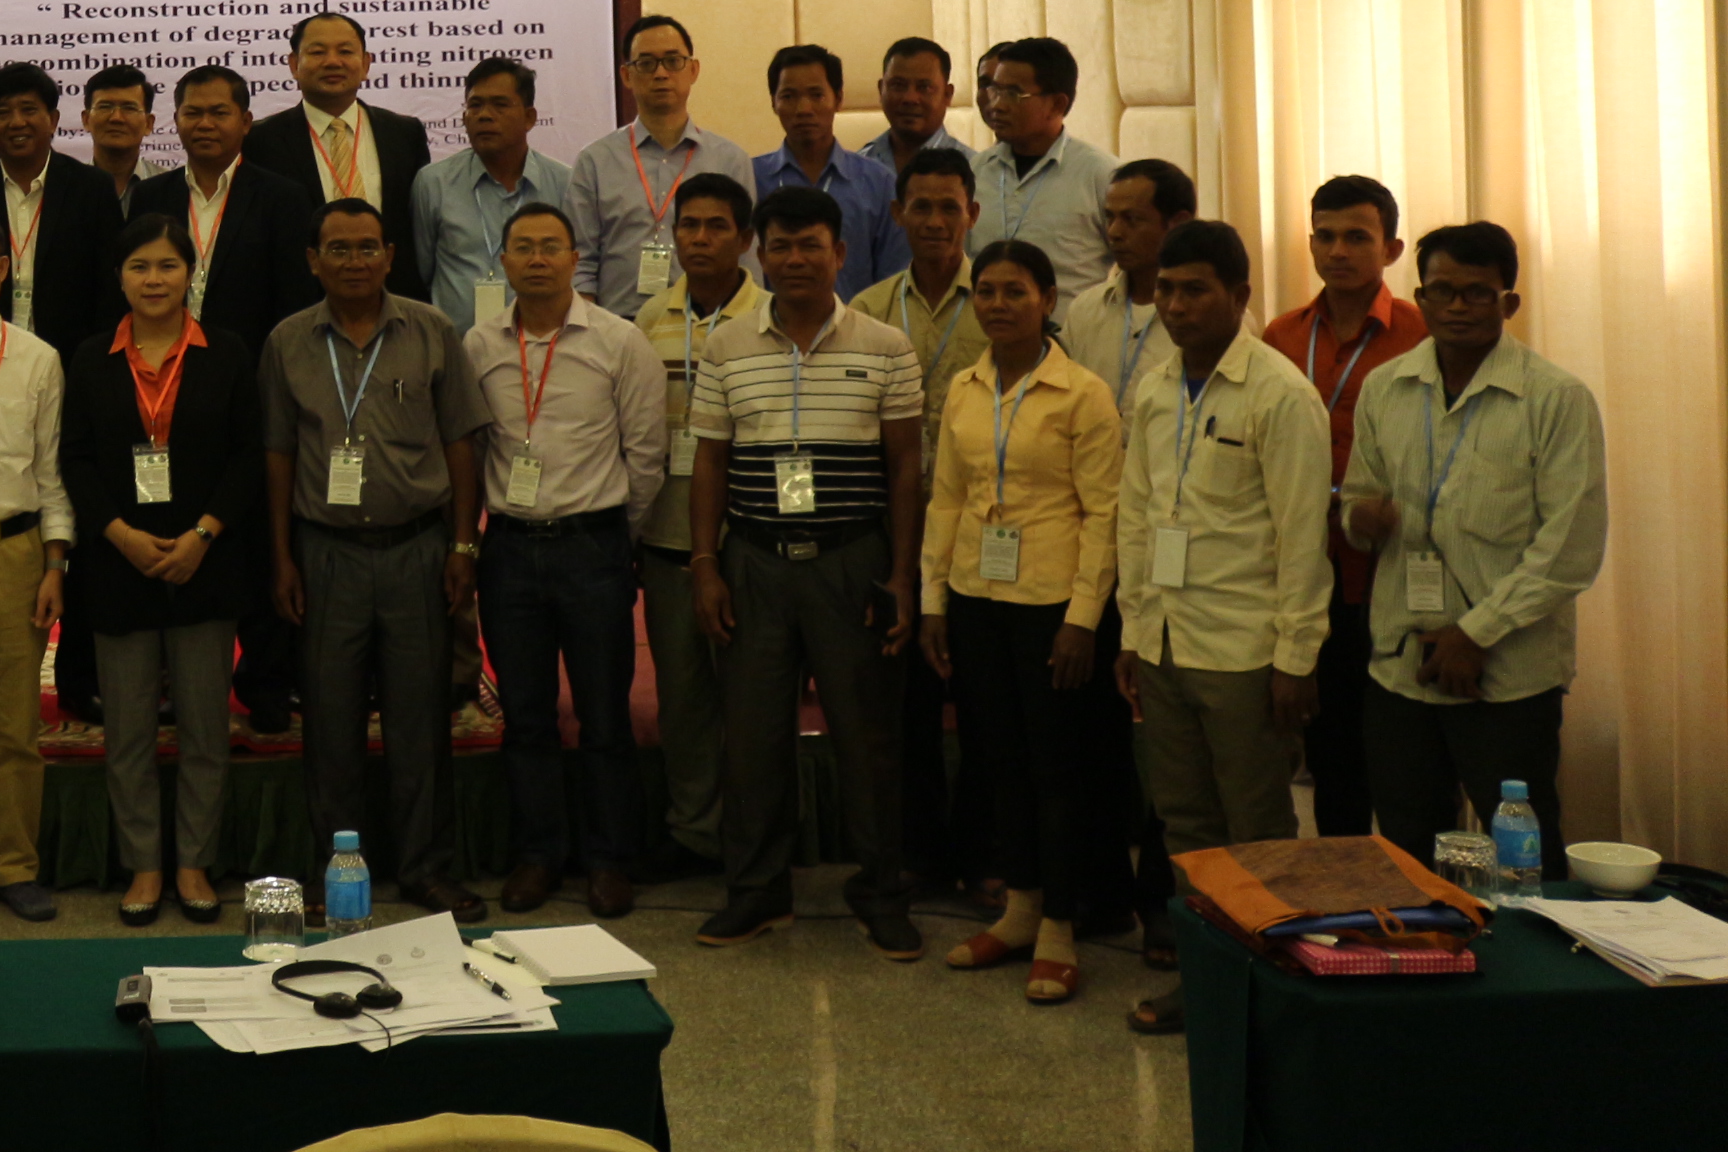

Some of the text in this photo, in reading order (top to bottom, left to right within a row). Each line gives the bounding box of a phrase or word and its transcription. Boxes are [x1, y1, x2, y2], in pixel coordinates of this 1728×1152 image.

[61, 0, 269, 20] Reconstruction
[169, 25, 197, 44] of
[428, 19, 504, 38] based
[513, 22, 546, 36] on
[206, 51, 236, 67] of
[441, 45, 554, 65] nitrogen
